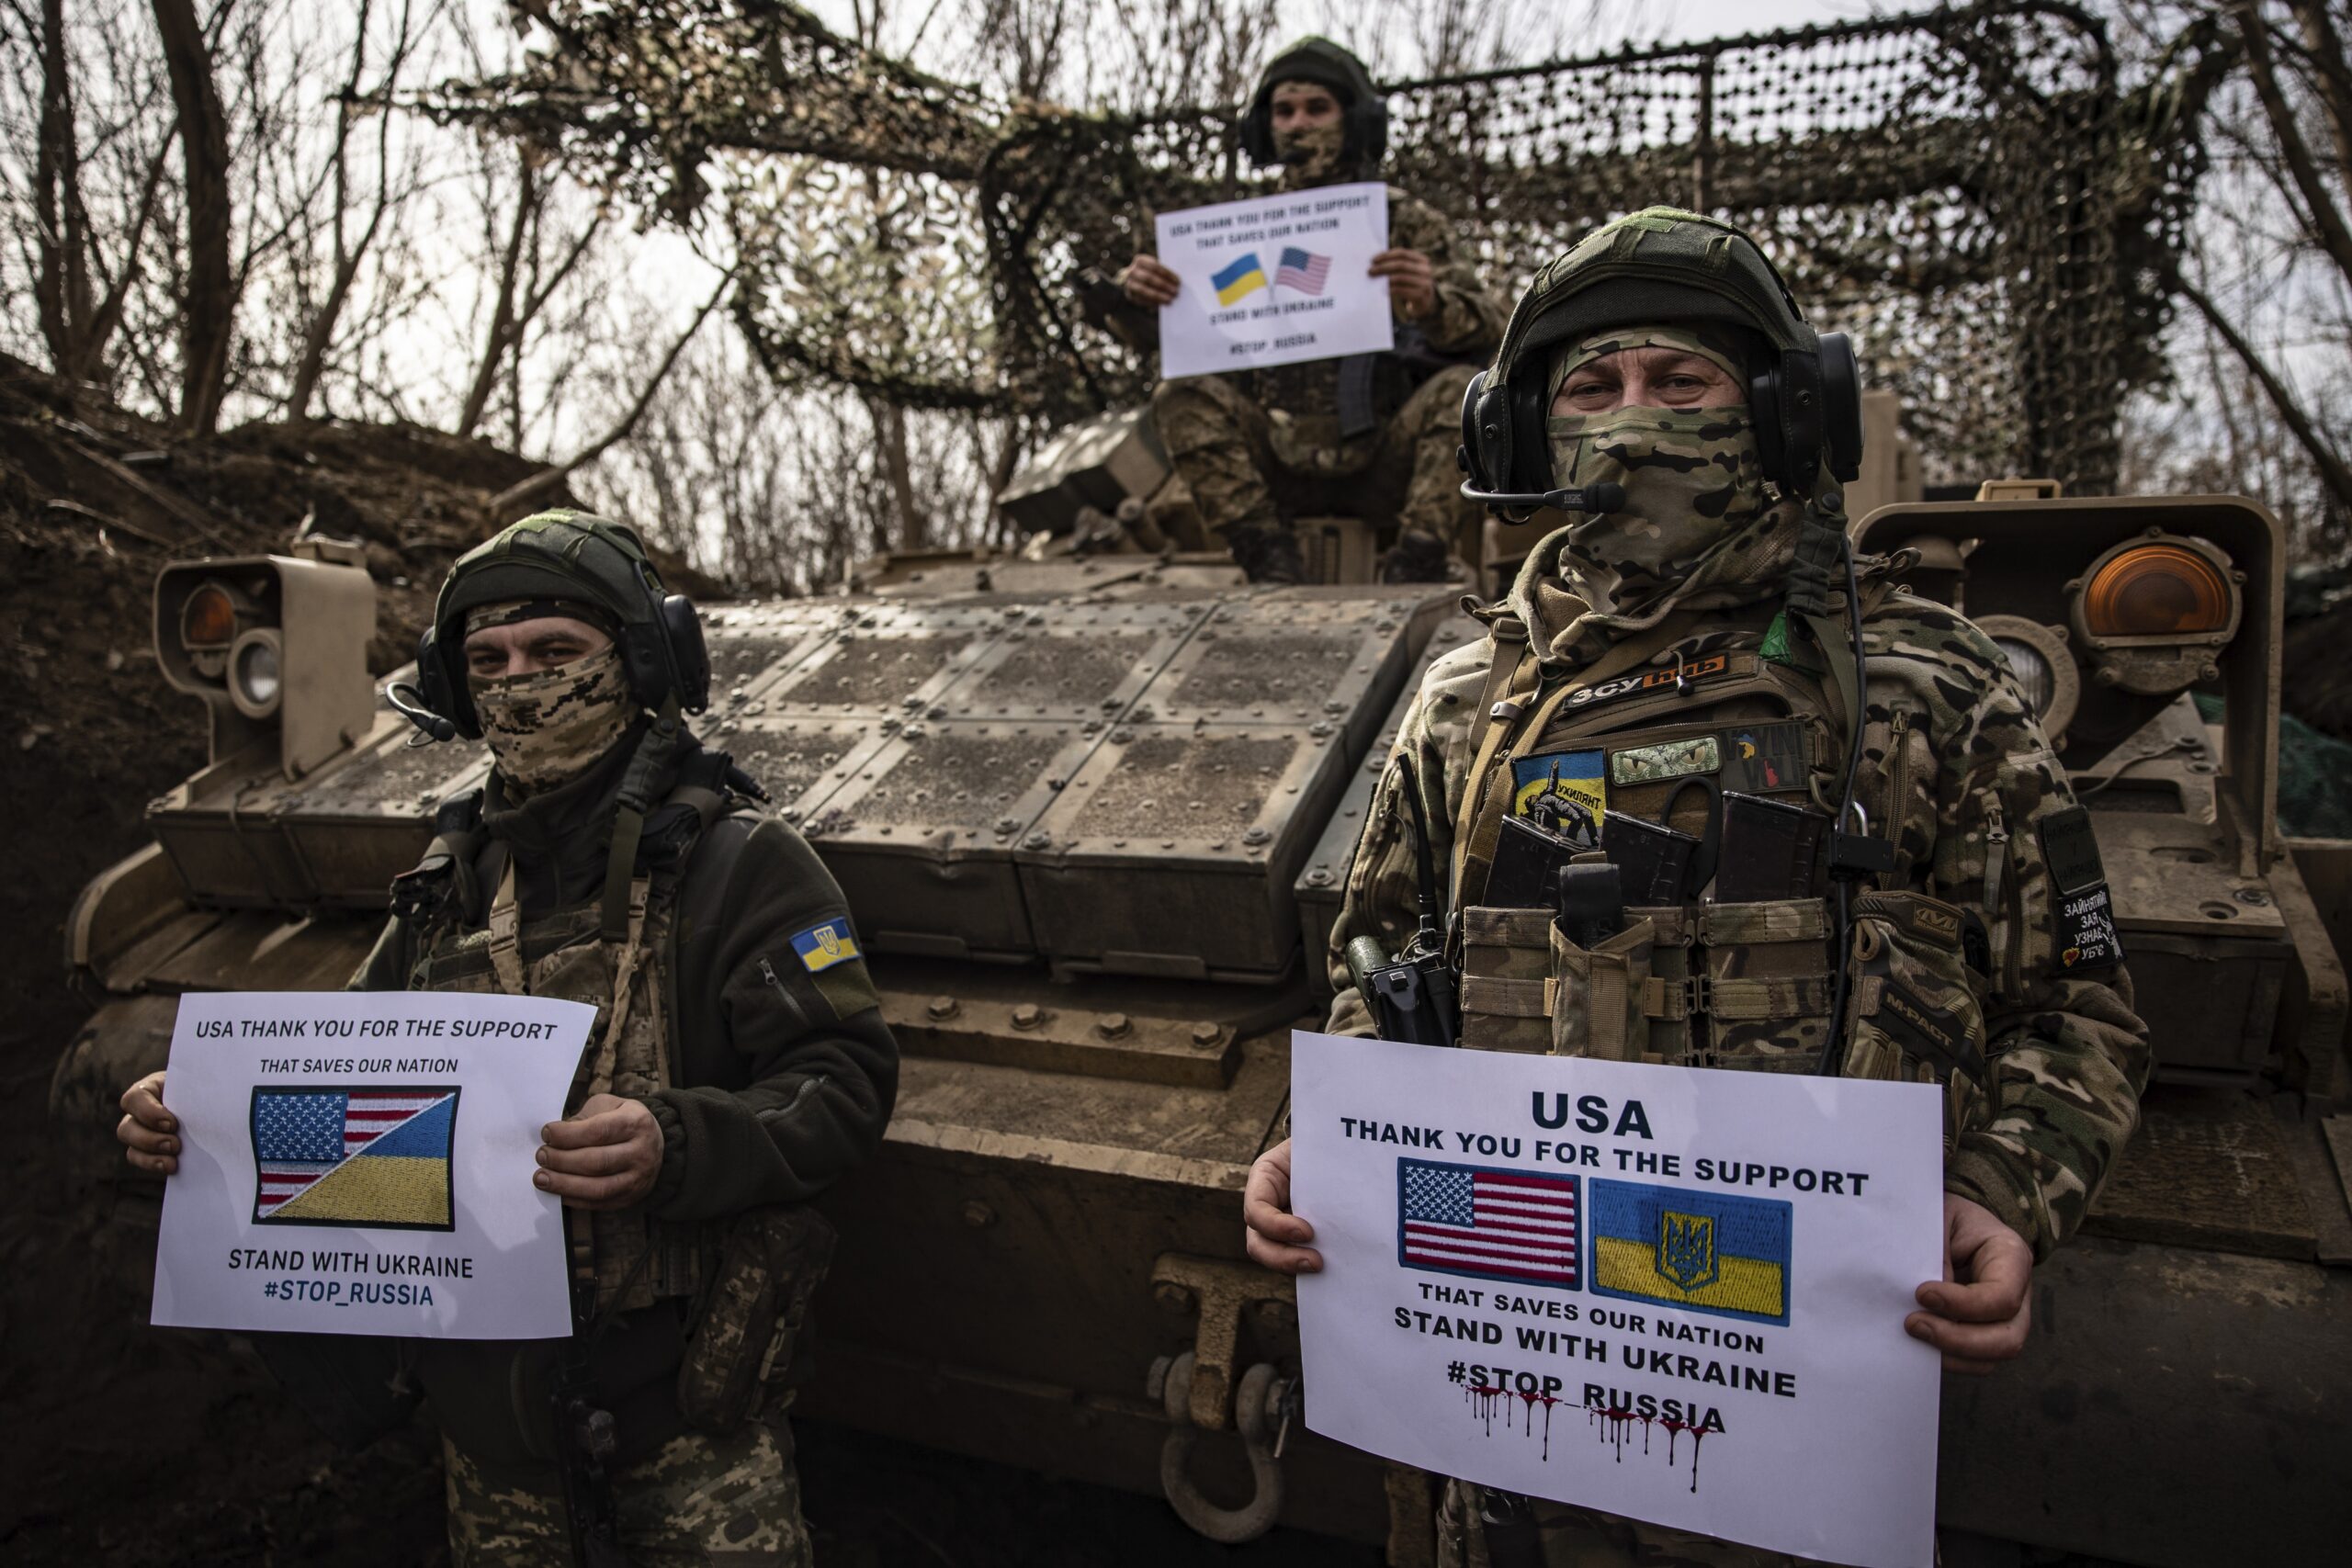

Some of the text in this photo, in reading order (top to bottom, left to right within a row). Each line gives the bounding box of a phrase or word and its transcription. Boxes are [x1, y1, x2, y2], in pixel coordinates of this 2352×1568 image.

[1170, 197, 1370, 236] USA THANK YOU FOR THE SUPPORT
[1197, 219, 1340, 248] THAT SAVES OUR NATION
[1210, 299, 1334, 324] STAND WITH UKRAINE
[1558, 784, 1601, 809] УХИЛЯНТ
[197, 1020, 558, 1040] USA THANK YOU FOR THE SUPPORT
[1886, 992, 1954, 1046] M-PACT
[261, 1059, 458, 1073] THAT SAVES OUR NATION
[1532, 1091, 1654, 1140] USA
[1340, 1117, 1869, 1197] THANK YOU FOR THE SUPPORT
[229, 1248, 473, 1279] STAND WITH UKRAINE
[265, 1280, 433, 1306] #STOP_RUSSIA
[1419, 1282, 1763, 1354] THAT SAVES OUR NATION
[1395, 1307, 1795, 1398] STAND WITH UKRAINE
